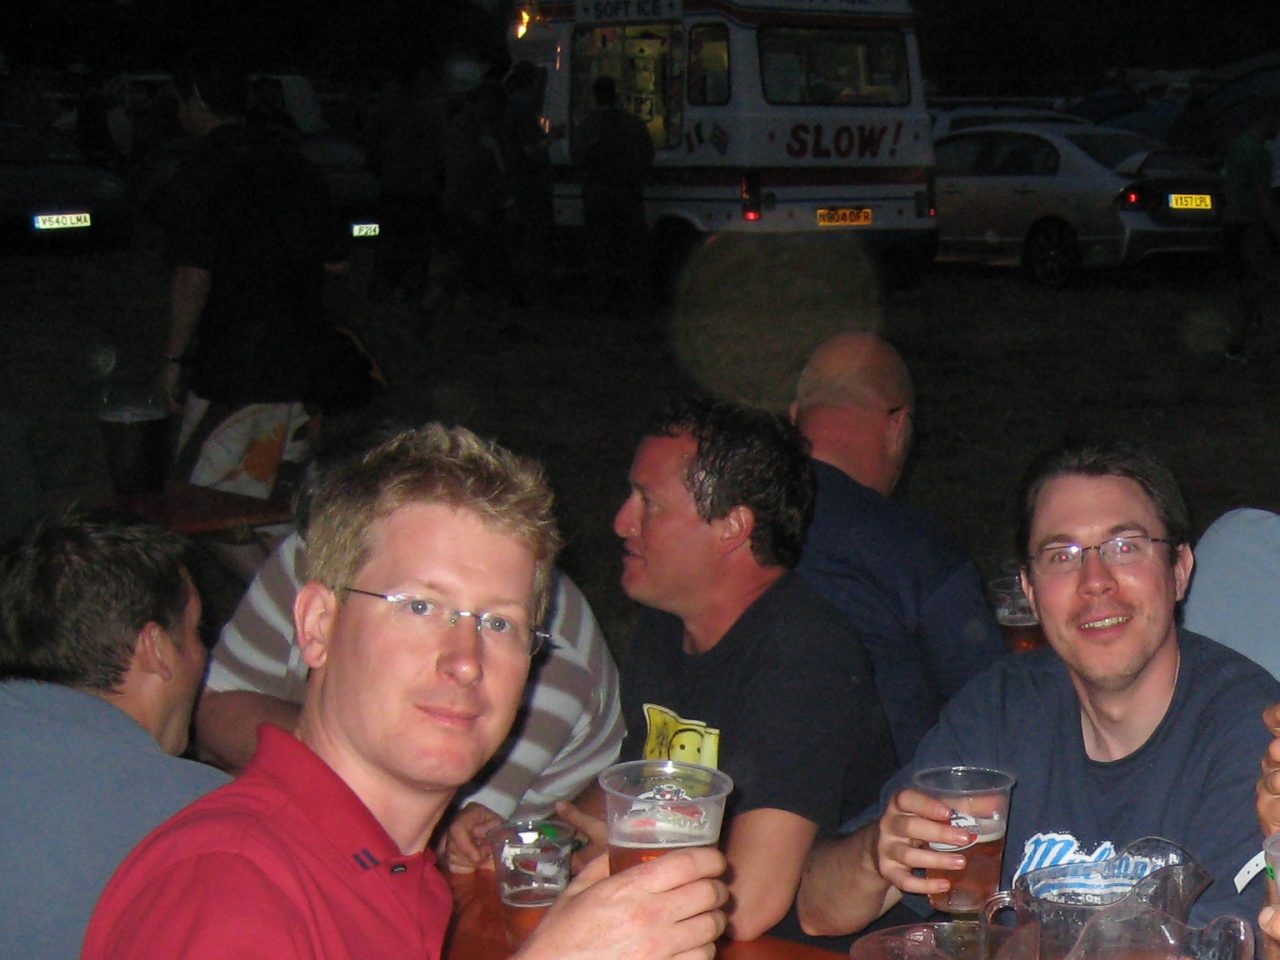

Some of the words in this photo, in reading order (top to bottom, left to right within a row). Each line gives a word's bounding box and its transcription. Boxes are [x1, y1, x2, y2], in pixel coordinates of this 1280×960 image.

[593, 0, 632, 19] SOFT
[637, 0, 663, 17] ICE
[786, 121, 904, 159] SLOW!
